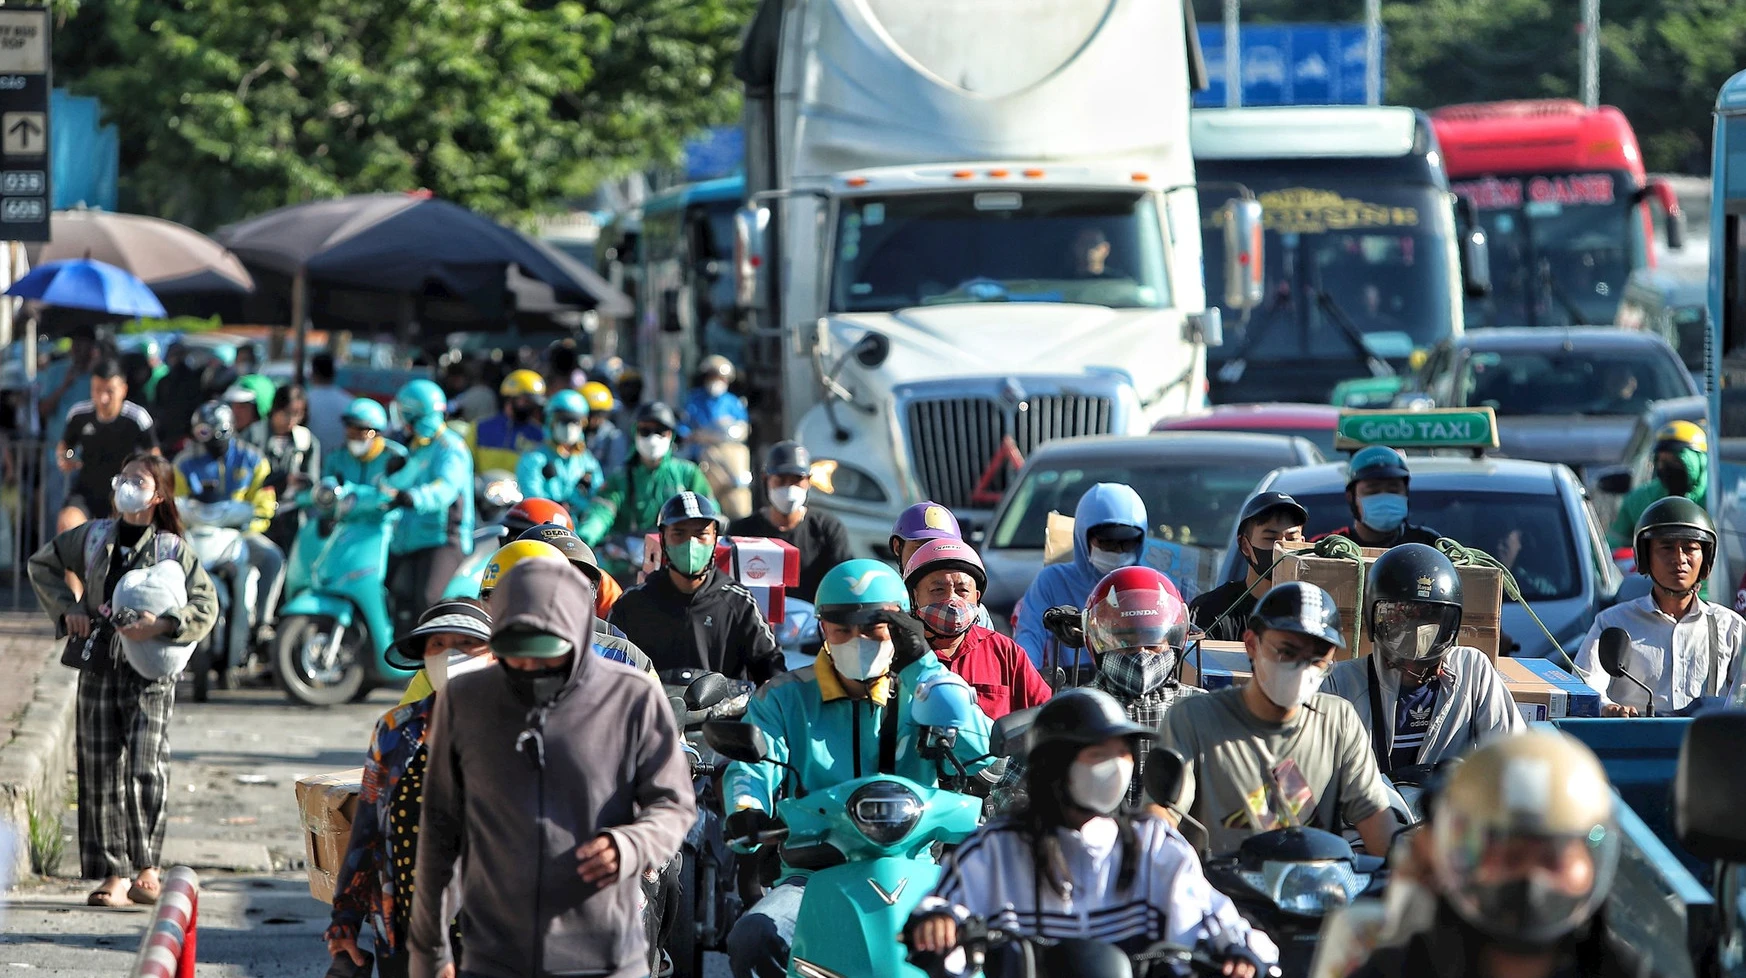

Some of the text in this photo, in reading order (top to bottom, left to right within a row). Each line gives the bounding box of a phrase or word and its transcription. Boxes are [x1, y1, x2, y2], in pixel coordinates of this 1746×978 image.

[1360, 418, 1472, 441] Grab TAXI
[1120, 609, 1160, 618] HONDA
[1409, 719, 1430, 728] adida
